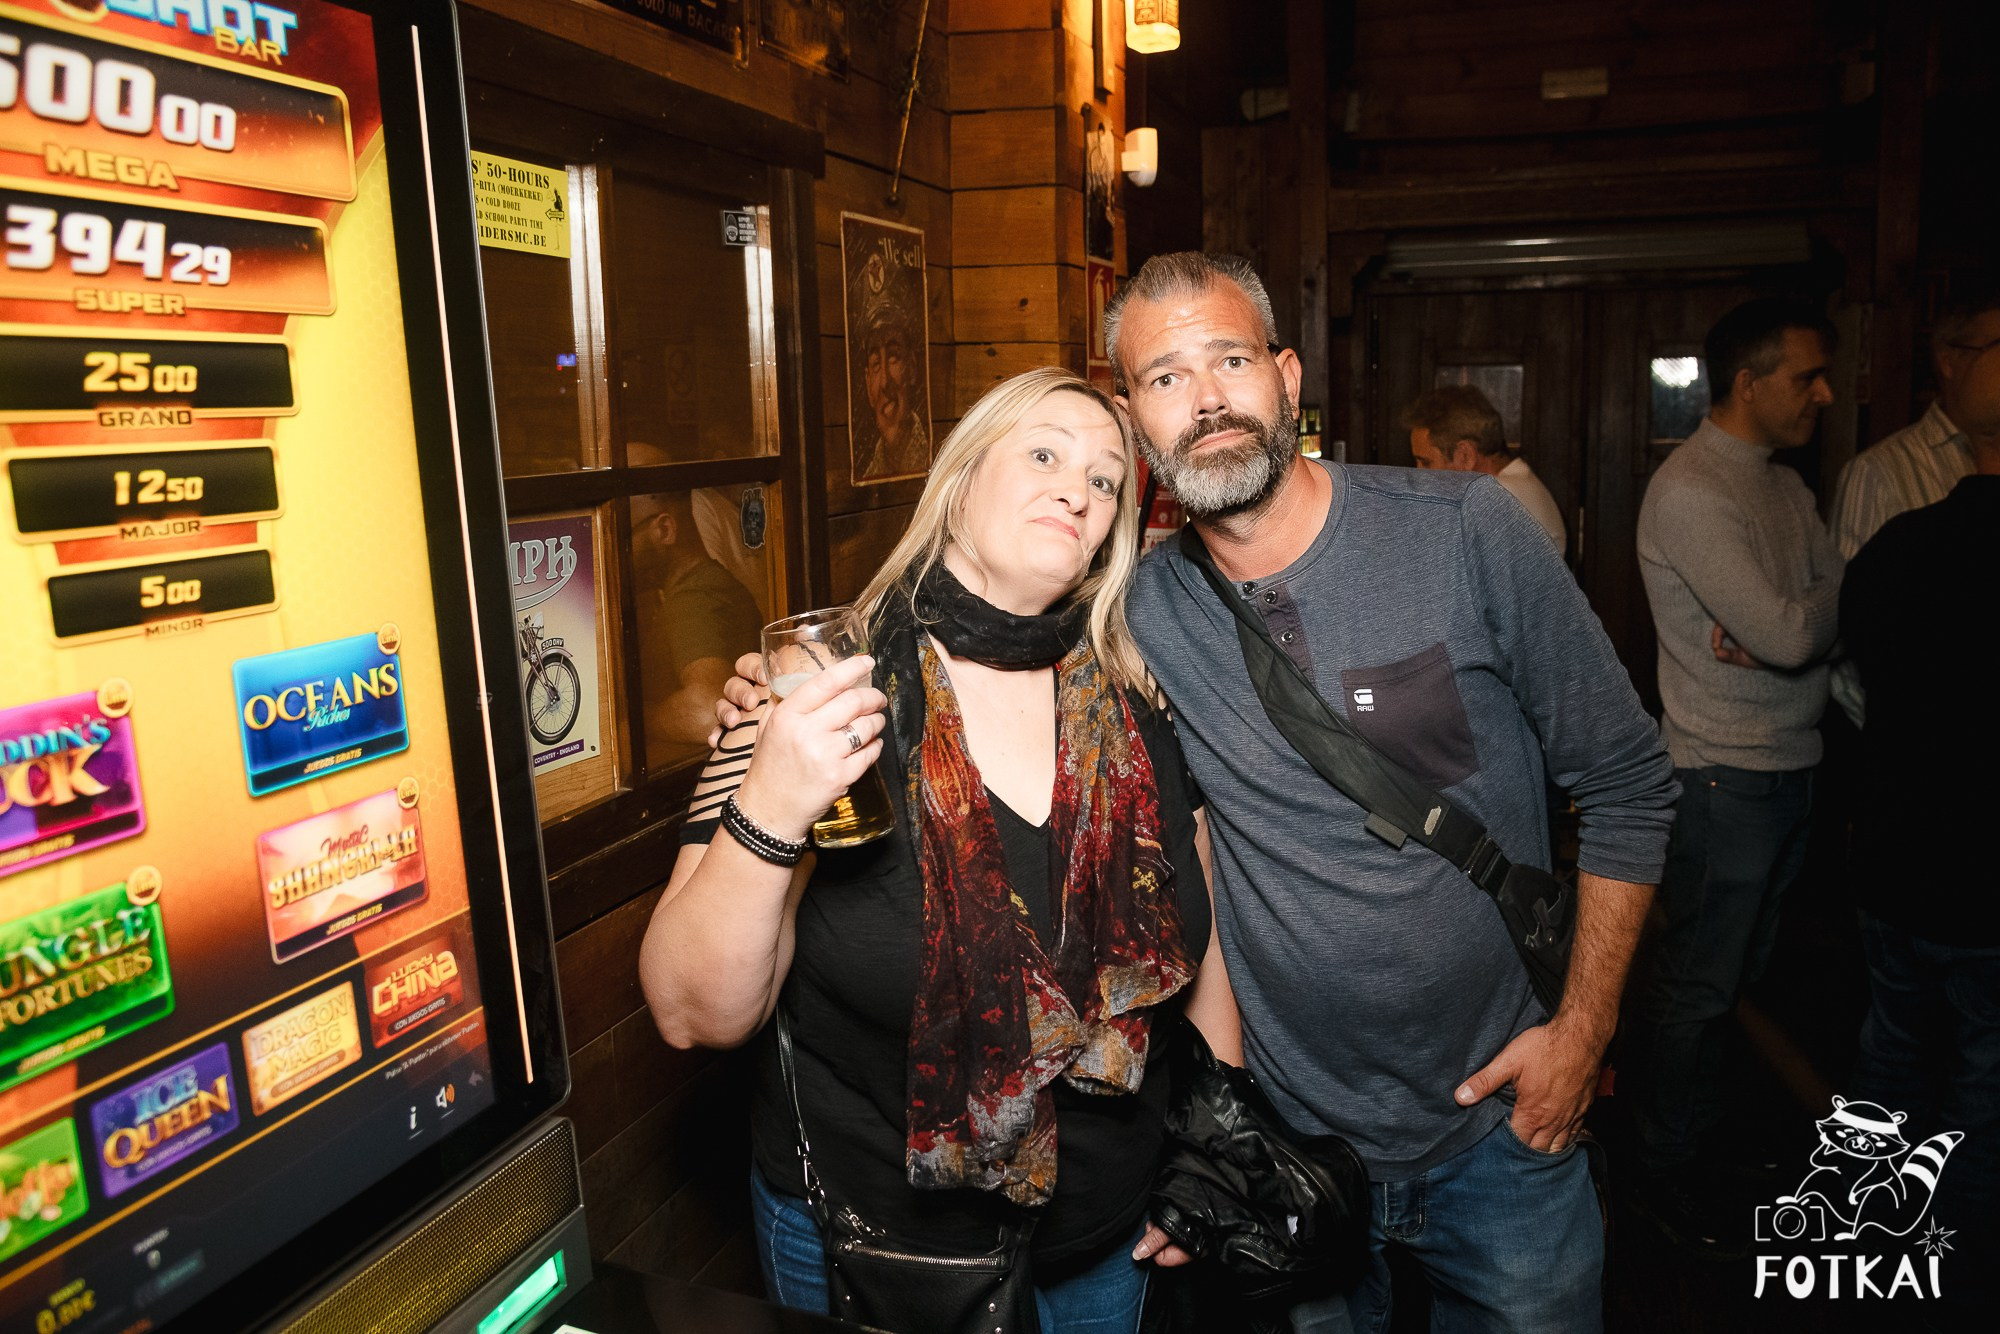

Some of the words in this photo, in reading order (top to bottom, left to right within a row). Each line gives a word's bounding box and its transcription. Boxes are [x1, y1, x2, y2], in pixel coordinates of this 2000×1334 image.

[213, 26, 283, 66] BAR
[44, 143, 180, 192] MEGA
[487, 162, 550, 190] 50-HOURS
[485, 196, 501, 209] COLD
[502, 199, 521, 212] BOOZE
[497, 183, 545, 202] (MOERKERKE)
[484, 210, 509, 224] SCHOOL
[509, 215, 529, 229] PARTY
[529, 219, 544, 230] TIME
[478, 225, 547, 248] IDERSMC.BE
[902, 244, 922, 270] sell
[73, 288, 186, 315] SUPER
[98, 409, 193, 428] GRAND
[119, 519, 201, 541] MAJOR
[144, 617, 205, 638] MINOR
[243, 662, 399, 731] OCEANS
[303, 756, 335, 774] JUEGOS
[334, 748, 363, 765] GRATIS
[534, 750, 557, 765] COVENTRY
[559, 743, 581, 756] ENGLAND
[326, 915, 357, 936] JUEGOS
[356, 903, 383, 923] GRATIS
[391, 952, 434, 983] LUCKY
[248, 991, 349, 1061] DRAGON
[131, 1063, 200, 1126] ICE
[103, 1073, 231, 1169] QUEEN
